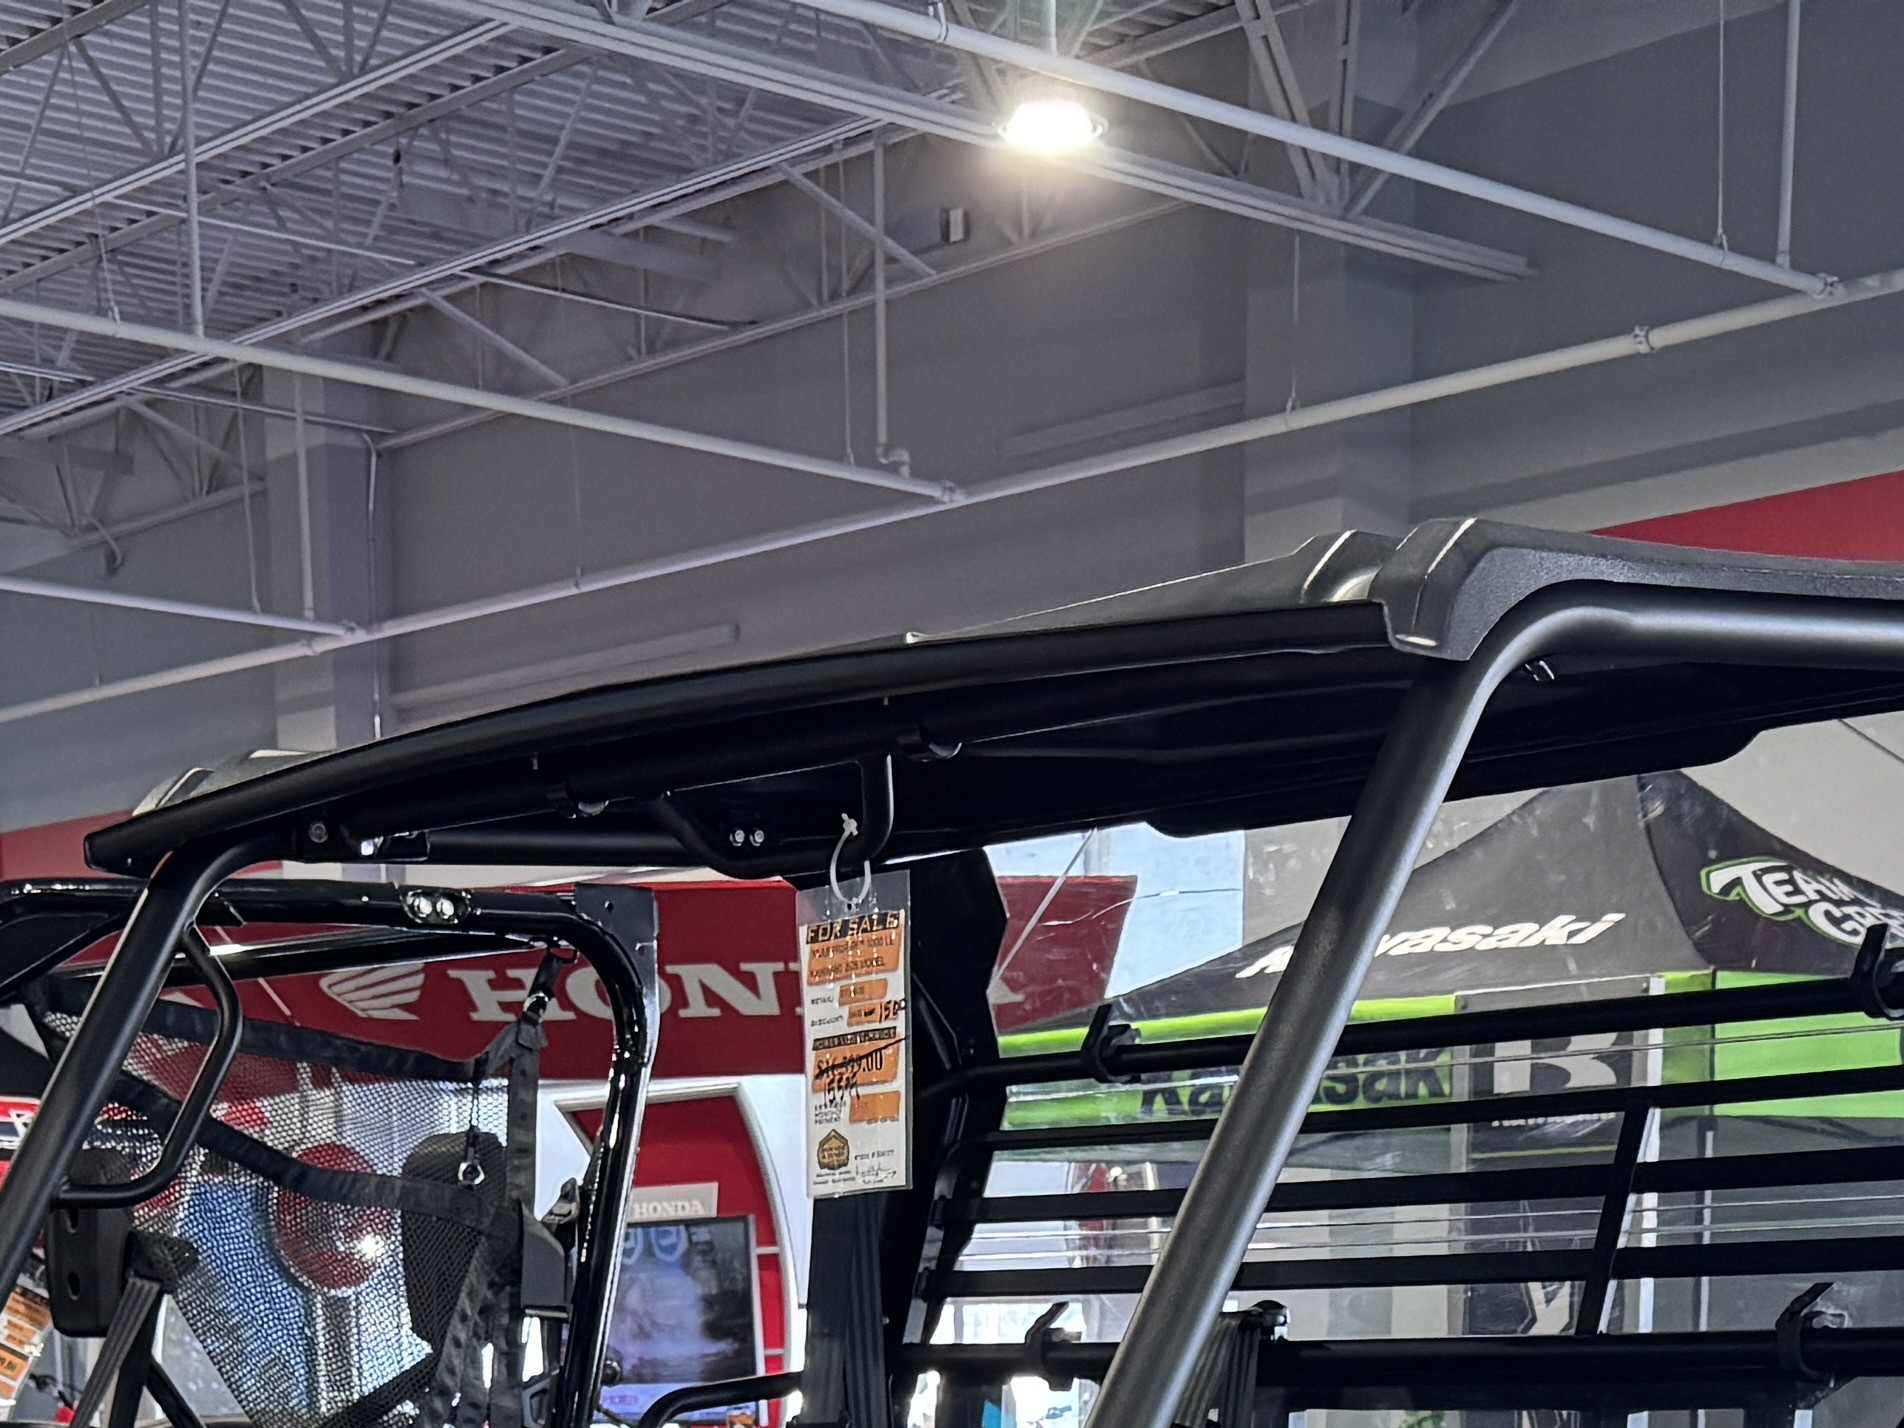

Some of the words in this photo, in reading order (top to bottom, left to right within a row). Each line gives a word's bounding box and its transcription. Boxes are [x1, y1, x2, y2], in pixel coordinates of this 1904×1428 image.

[1709, 862, 1881, 914] TEAM
[807, 919, 842, 943] FOR
[848, 911, 899, 937] SALE
[632, 1200, 705, 1218] HONDA
